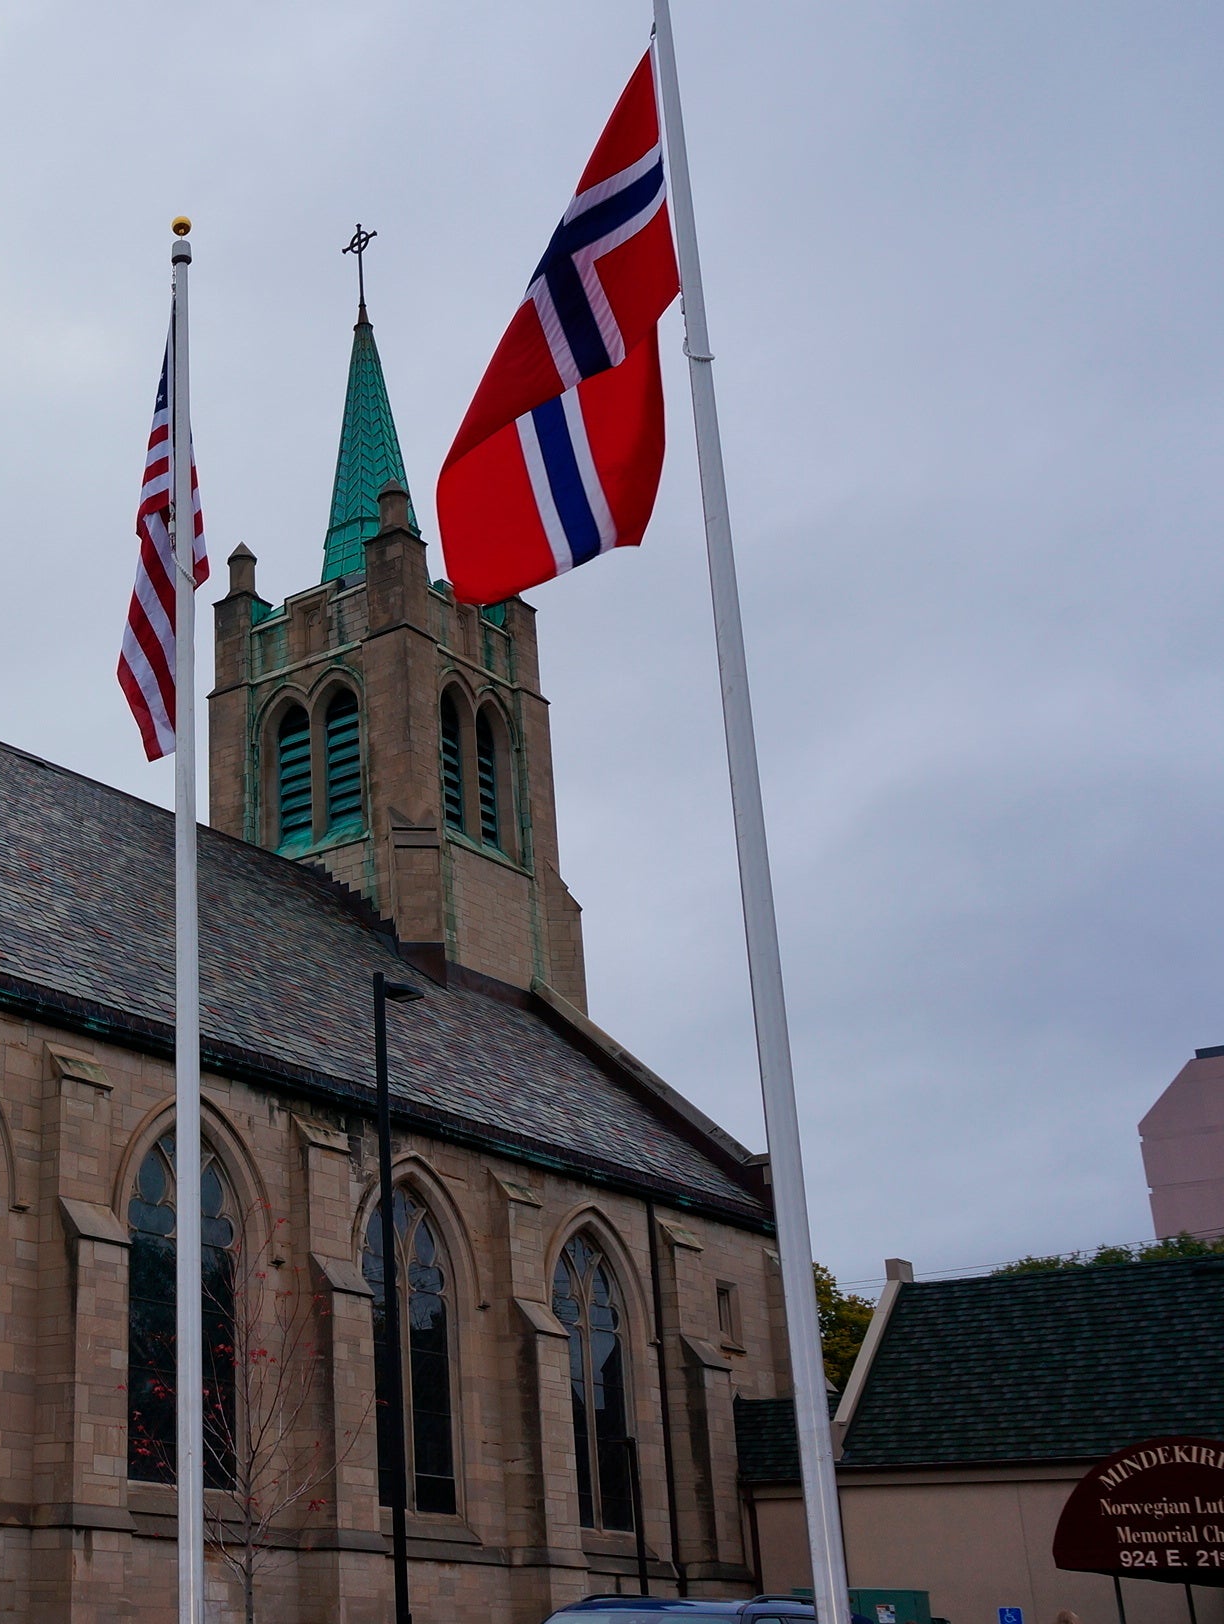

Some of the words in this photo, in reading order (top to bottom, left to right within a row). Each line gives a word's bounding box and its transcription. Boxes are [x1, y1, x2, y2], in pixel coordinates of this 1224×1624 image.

[1100, 1497, 1191, 1520] Norwegian
[1116, 1525, 1199, 1543] Memorial
[1120, 1550, 1158, 1567] 924
[1166, 1549, 1188, 1567] E.
